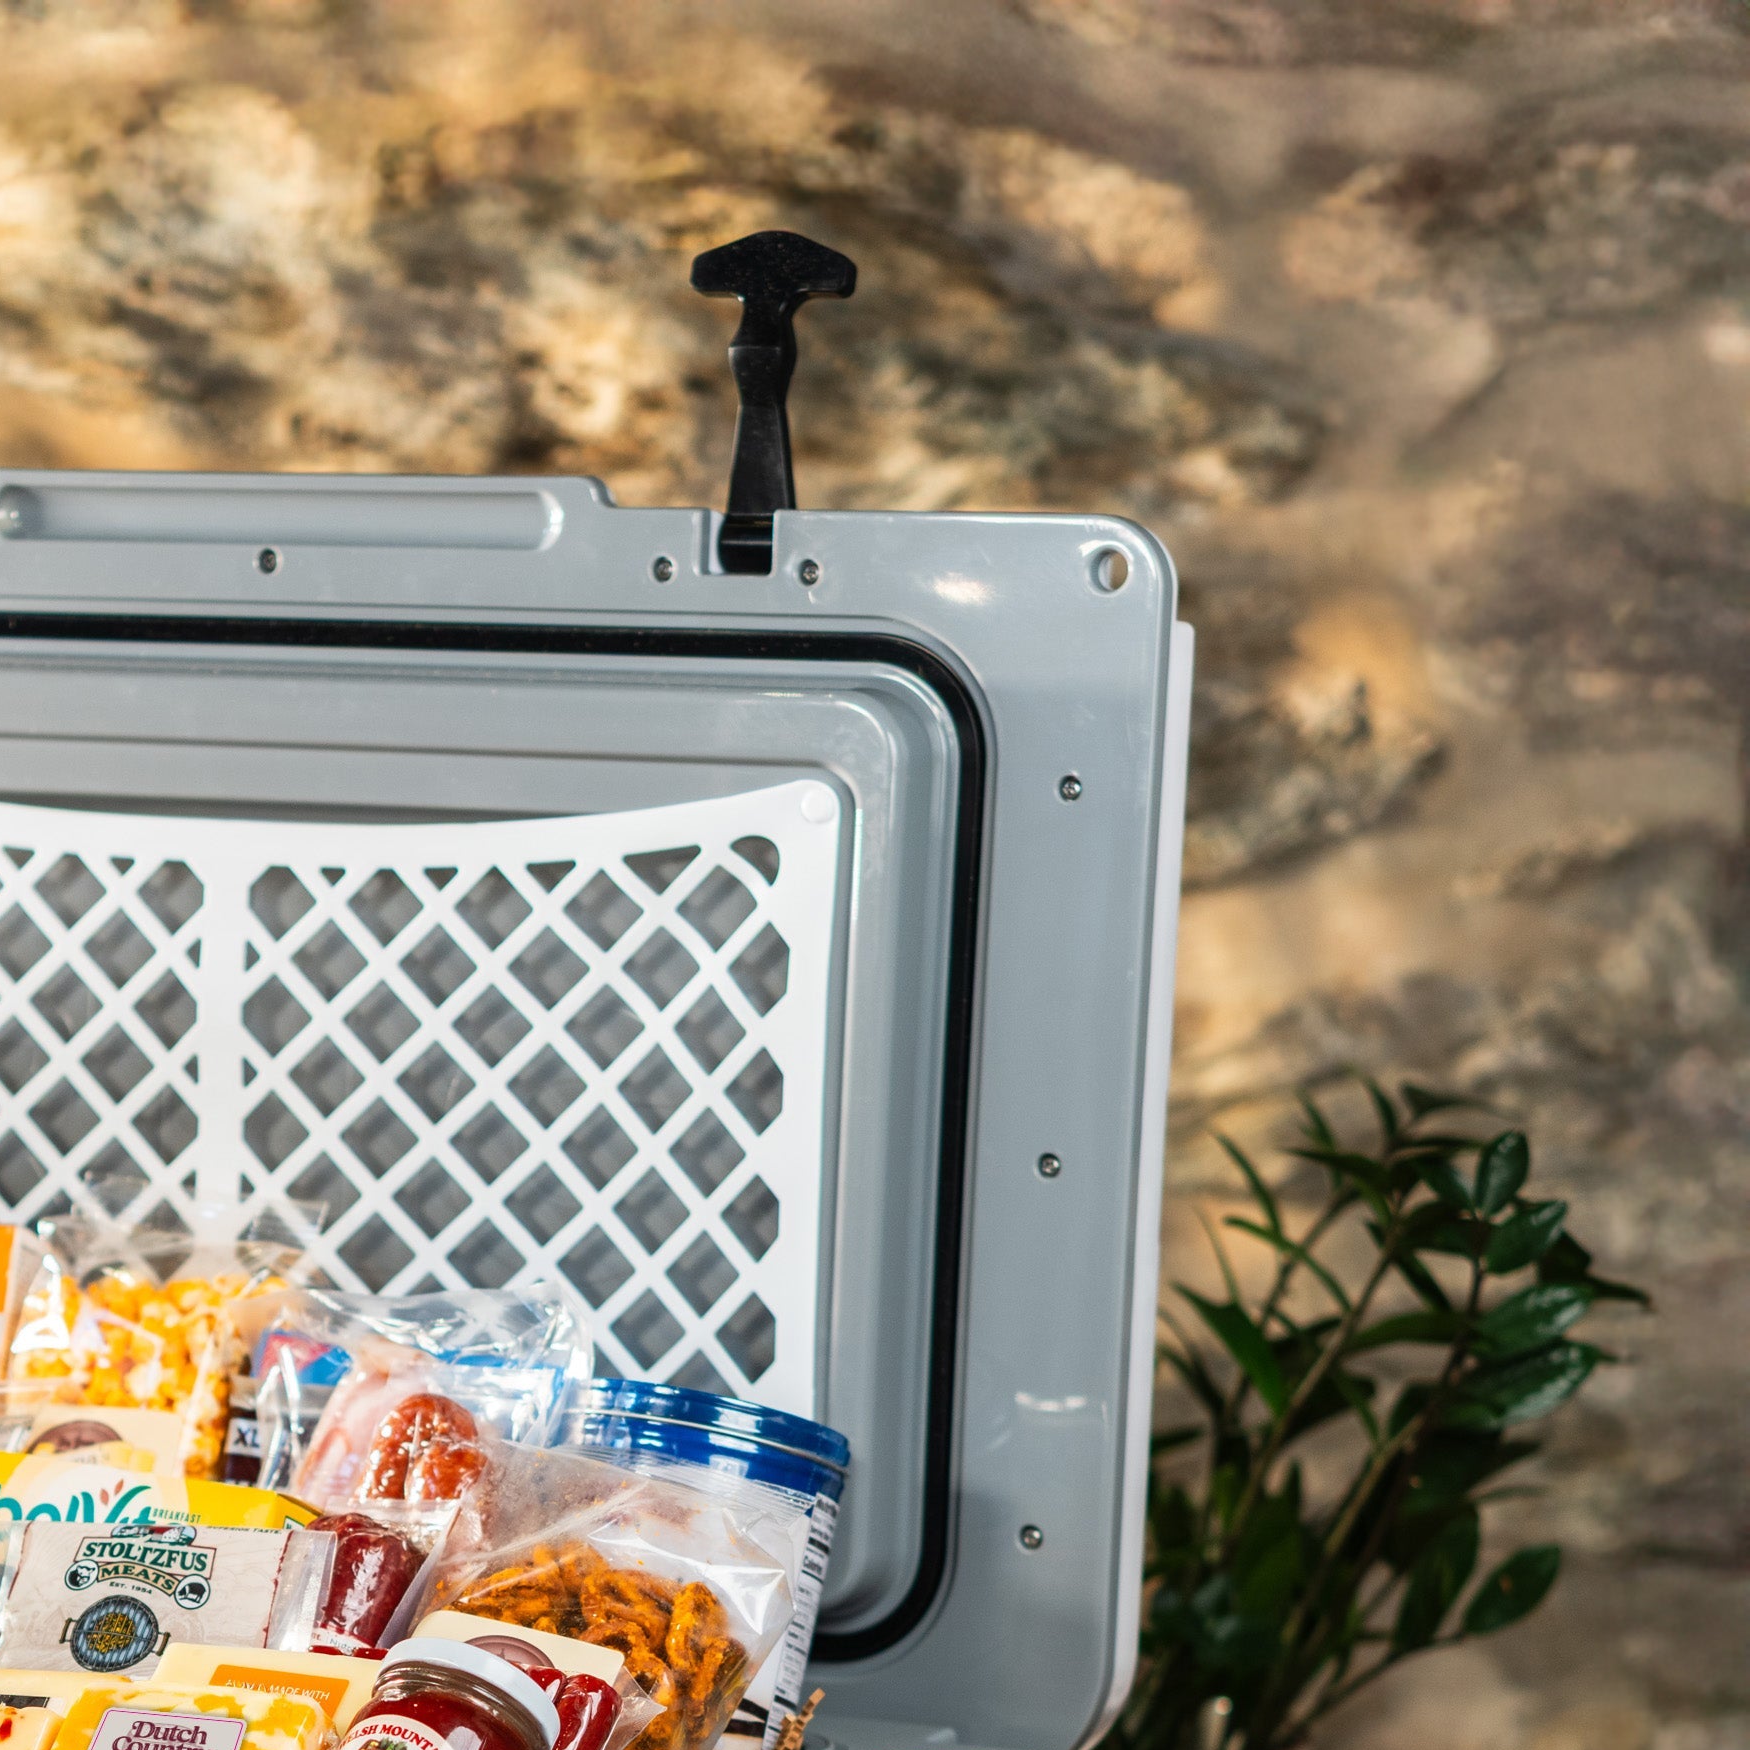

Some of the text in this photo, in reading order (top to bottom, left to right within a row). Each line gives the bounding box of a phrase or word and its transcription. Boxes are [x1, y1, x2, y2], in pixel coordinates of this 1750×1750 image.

[233, 1426, 261, 1448] XL
[152, 1508, 202, 1523] BREAKFAST
[83, 1542, 208, 1572] STOLTZFUS
[101, 1564, 176, 1592] MEATS
[300, 1687, 331, 1701] WITH
[132, 1720, 208, 1746] Dutch
